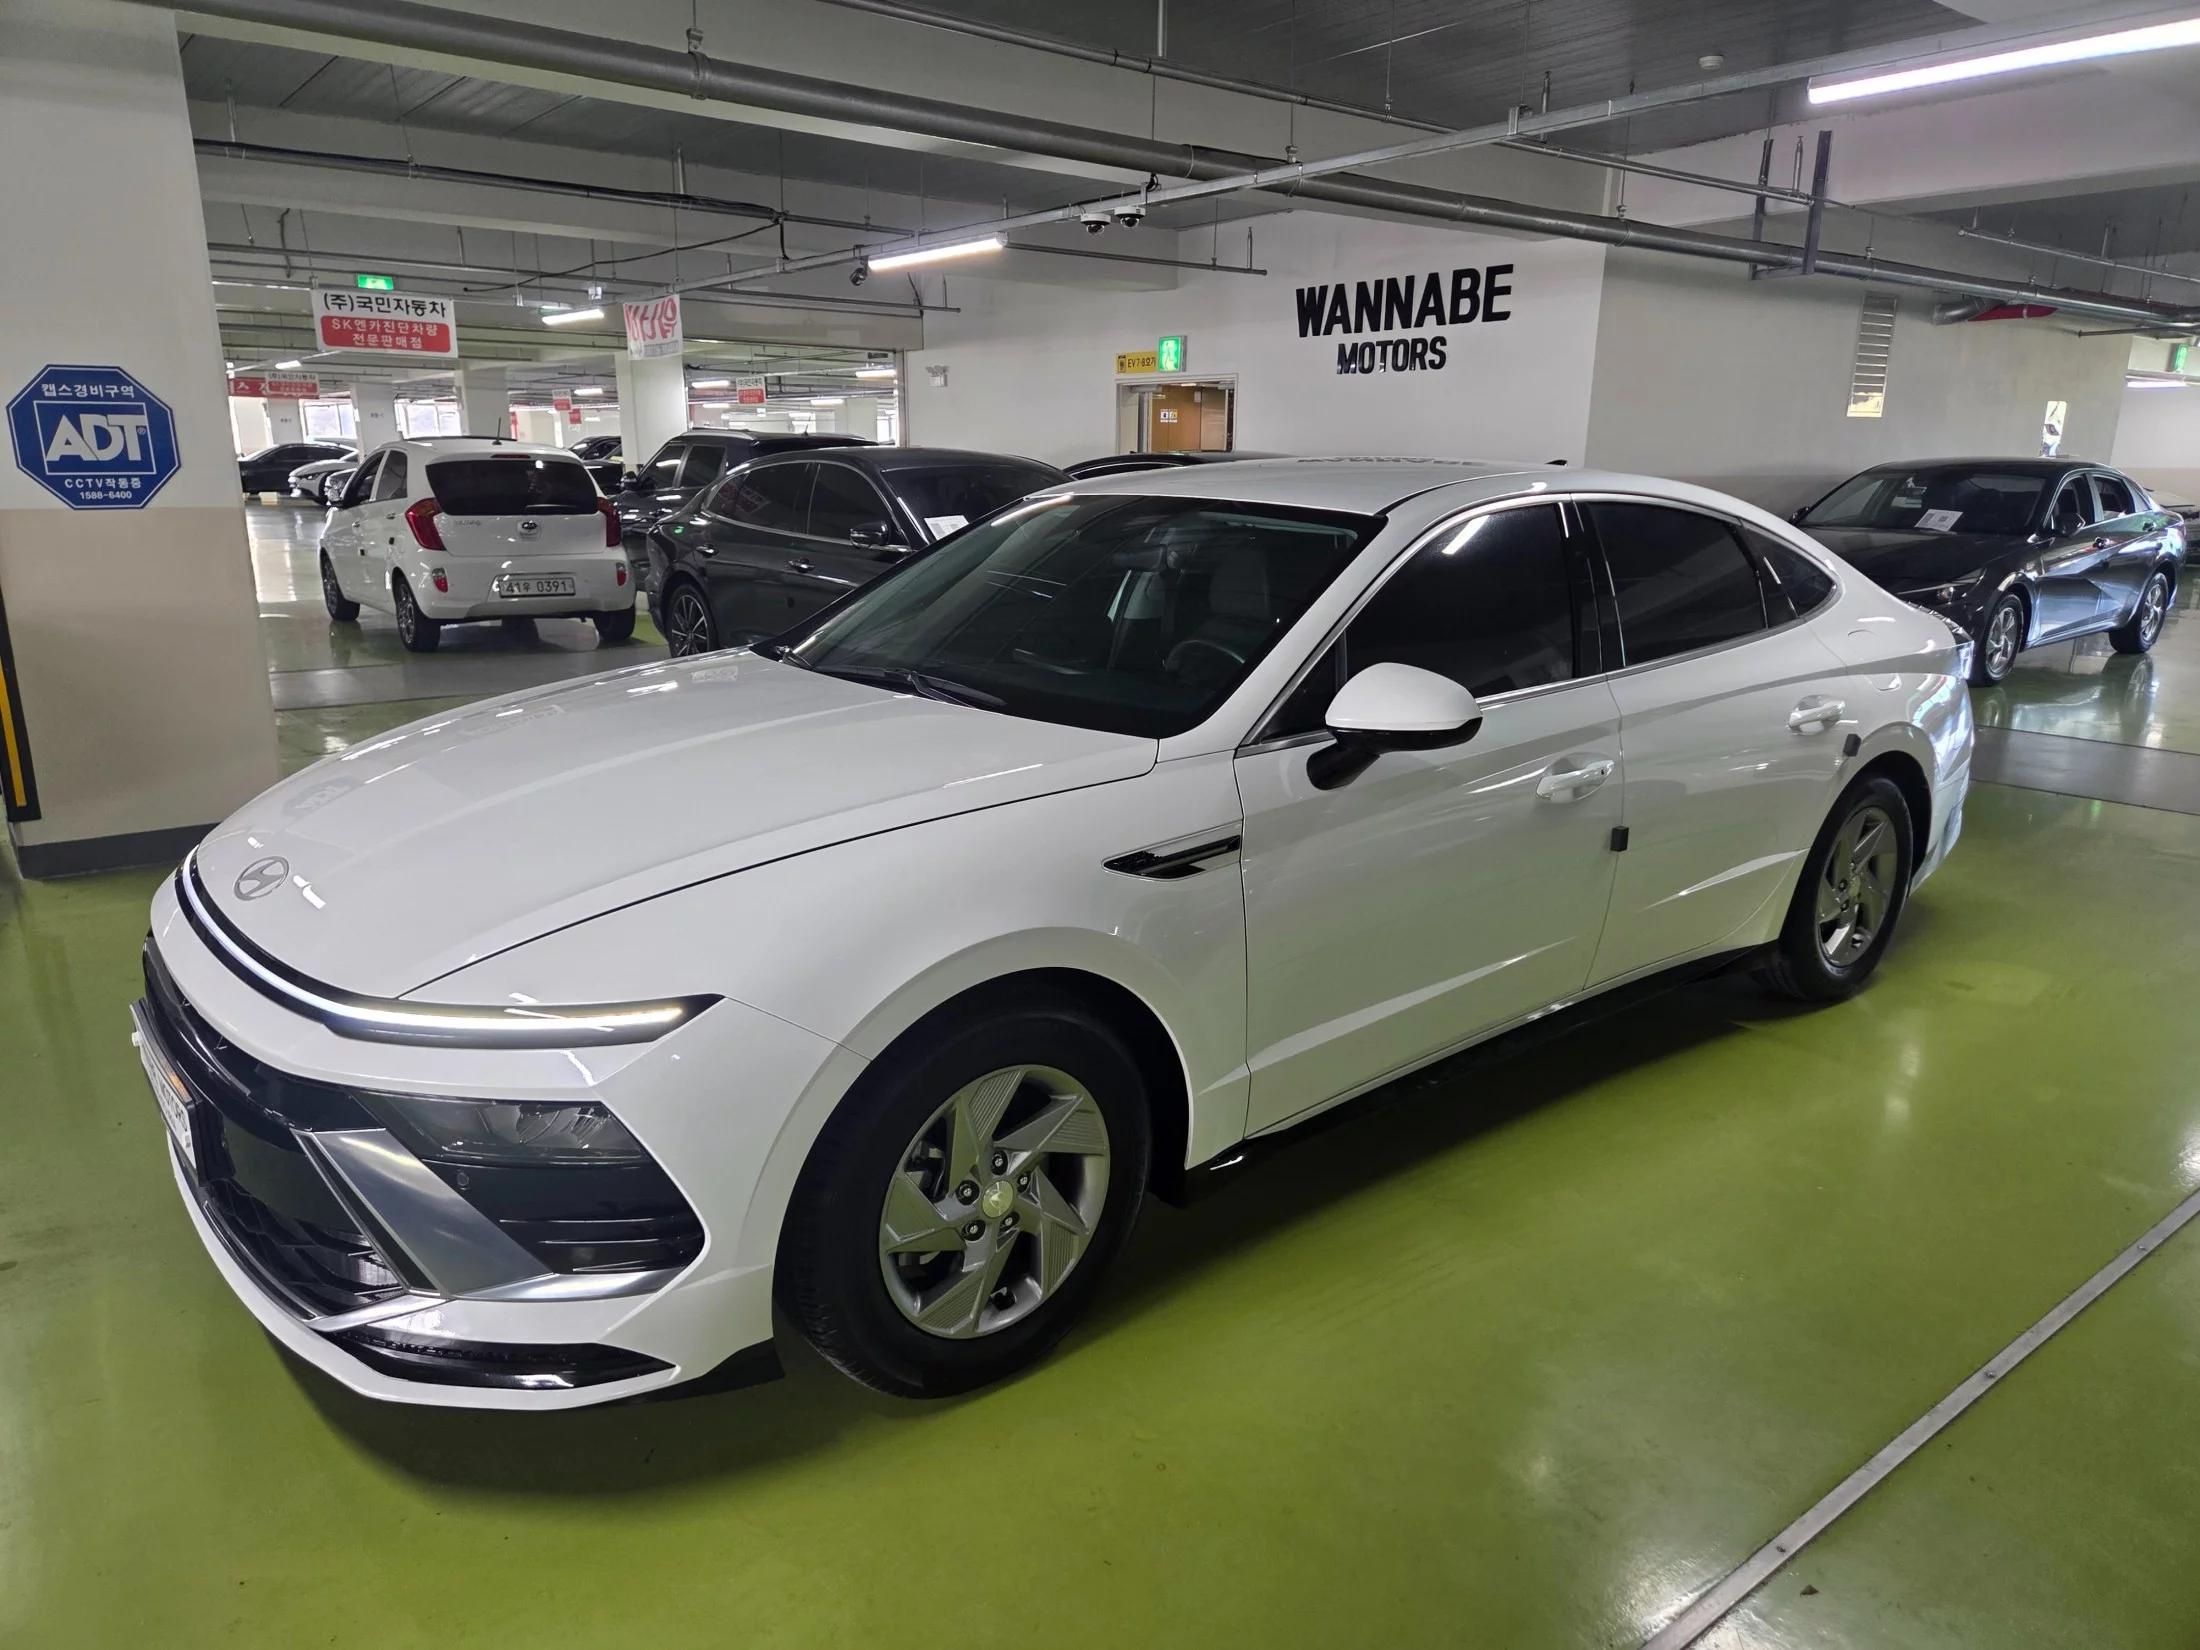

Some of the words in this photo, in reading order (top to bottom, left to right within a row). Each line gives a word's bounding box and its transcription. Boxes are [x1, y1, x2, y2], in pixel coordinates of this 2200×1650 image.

[323, 292, 446, 318] (주)국민자동차
[1295, 263, 1514, 338] WANNABE
[352, 333, 423, 349] 전문판매점
[1336, 336, 1447, 375] MOTORS
[41, 383, 135, 399] 캡스경비구역
[46, 413, 148, 462] ADT
[79, 490, 133, 500] 1588-6400
[536, 580, 567, 592] 0391
